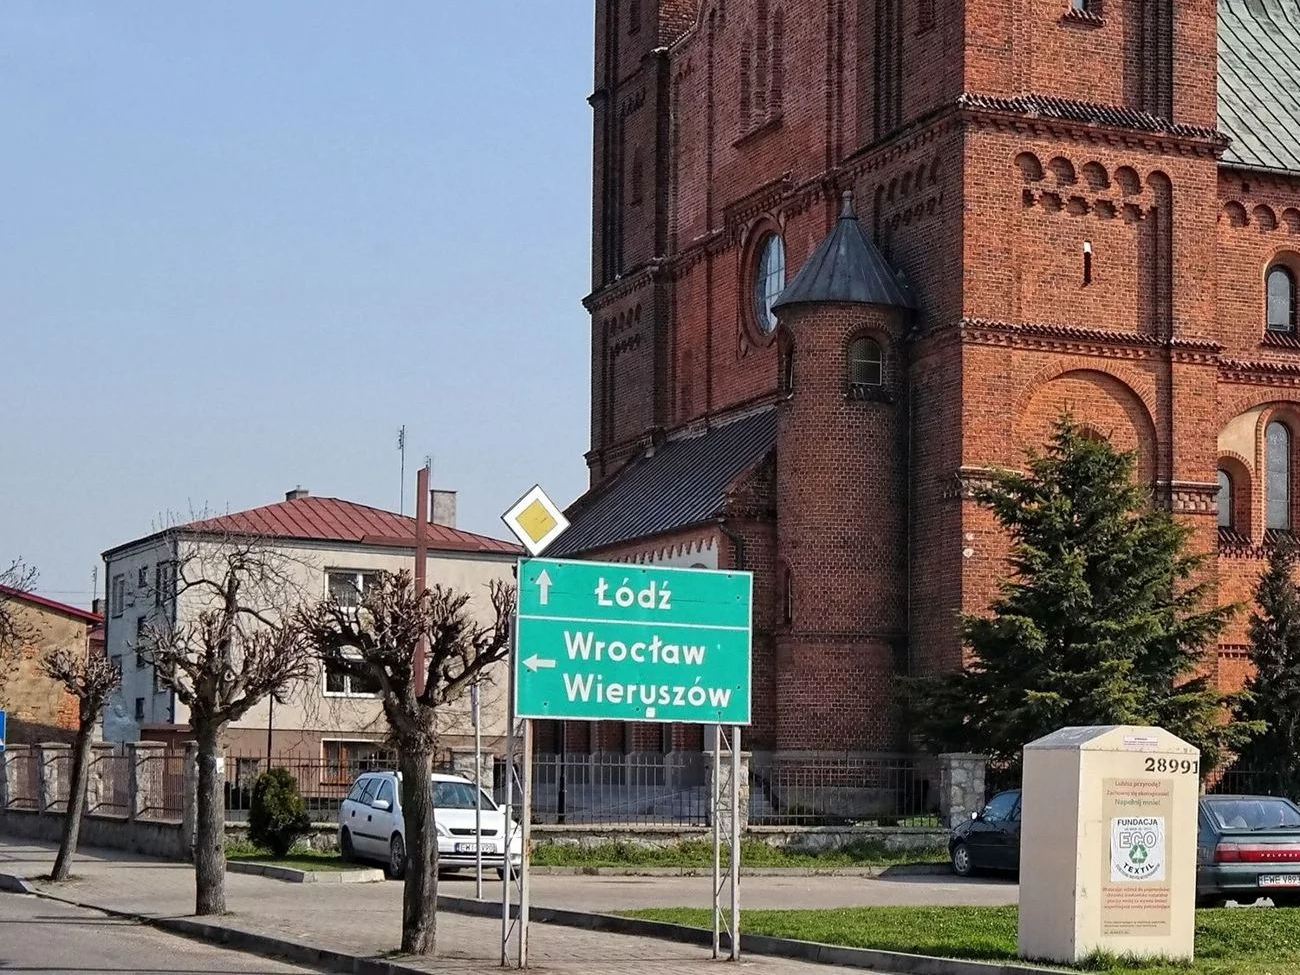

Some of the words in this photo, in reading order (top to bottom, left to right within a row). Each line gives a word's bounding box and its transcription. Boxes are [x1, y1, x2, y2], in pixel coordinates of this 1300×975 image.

[594, 577, 672, 610] Łódź
[563, 630, 706, 665] Wrocław
[563, 673, 732, 708] Wieruszów
[1145, 757, 1198, 774] 28991
[1117, 818, 1158, 826] FUNDACJA
[1119, 831, 1157, 849] ECO
[1123, 862, 1154, 874] TEXTIL
[1264, 875, 1280, 884] EWE
